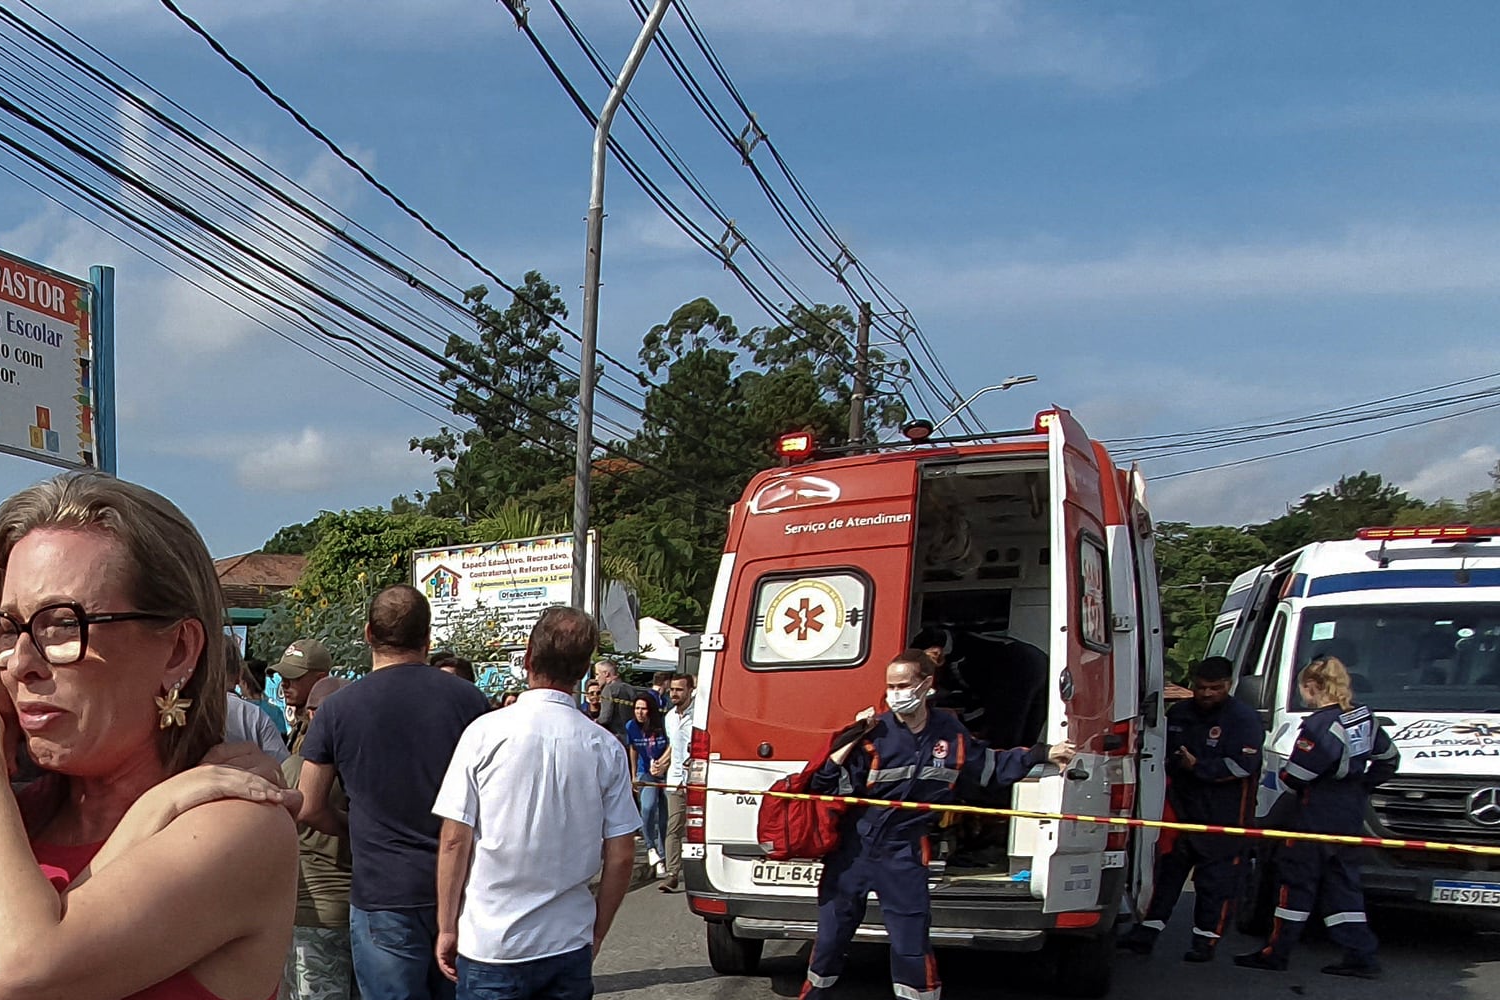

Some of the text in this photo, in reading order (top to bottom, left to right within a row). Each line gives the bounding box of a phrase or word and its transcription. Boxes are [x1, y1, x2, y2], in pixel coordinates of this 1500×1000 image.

[6, 310, 63, 348] Escolar
[14, 347, 44, 369] com
[784, 522, 826, 535] Serviço
[828, 518, 843, 530] de
